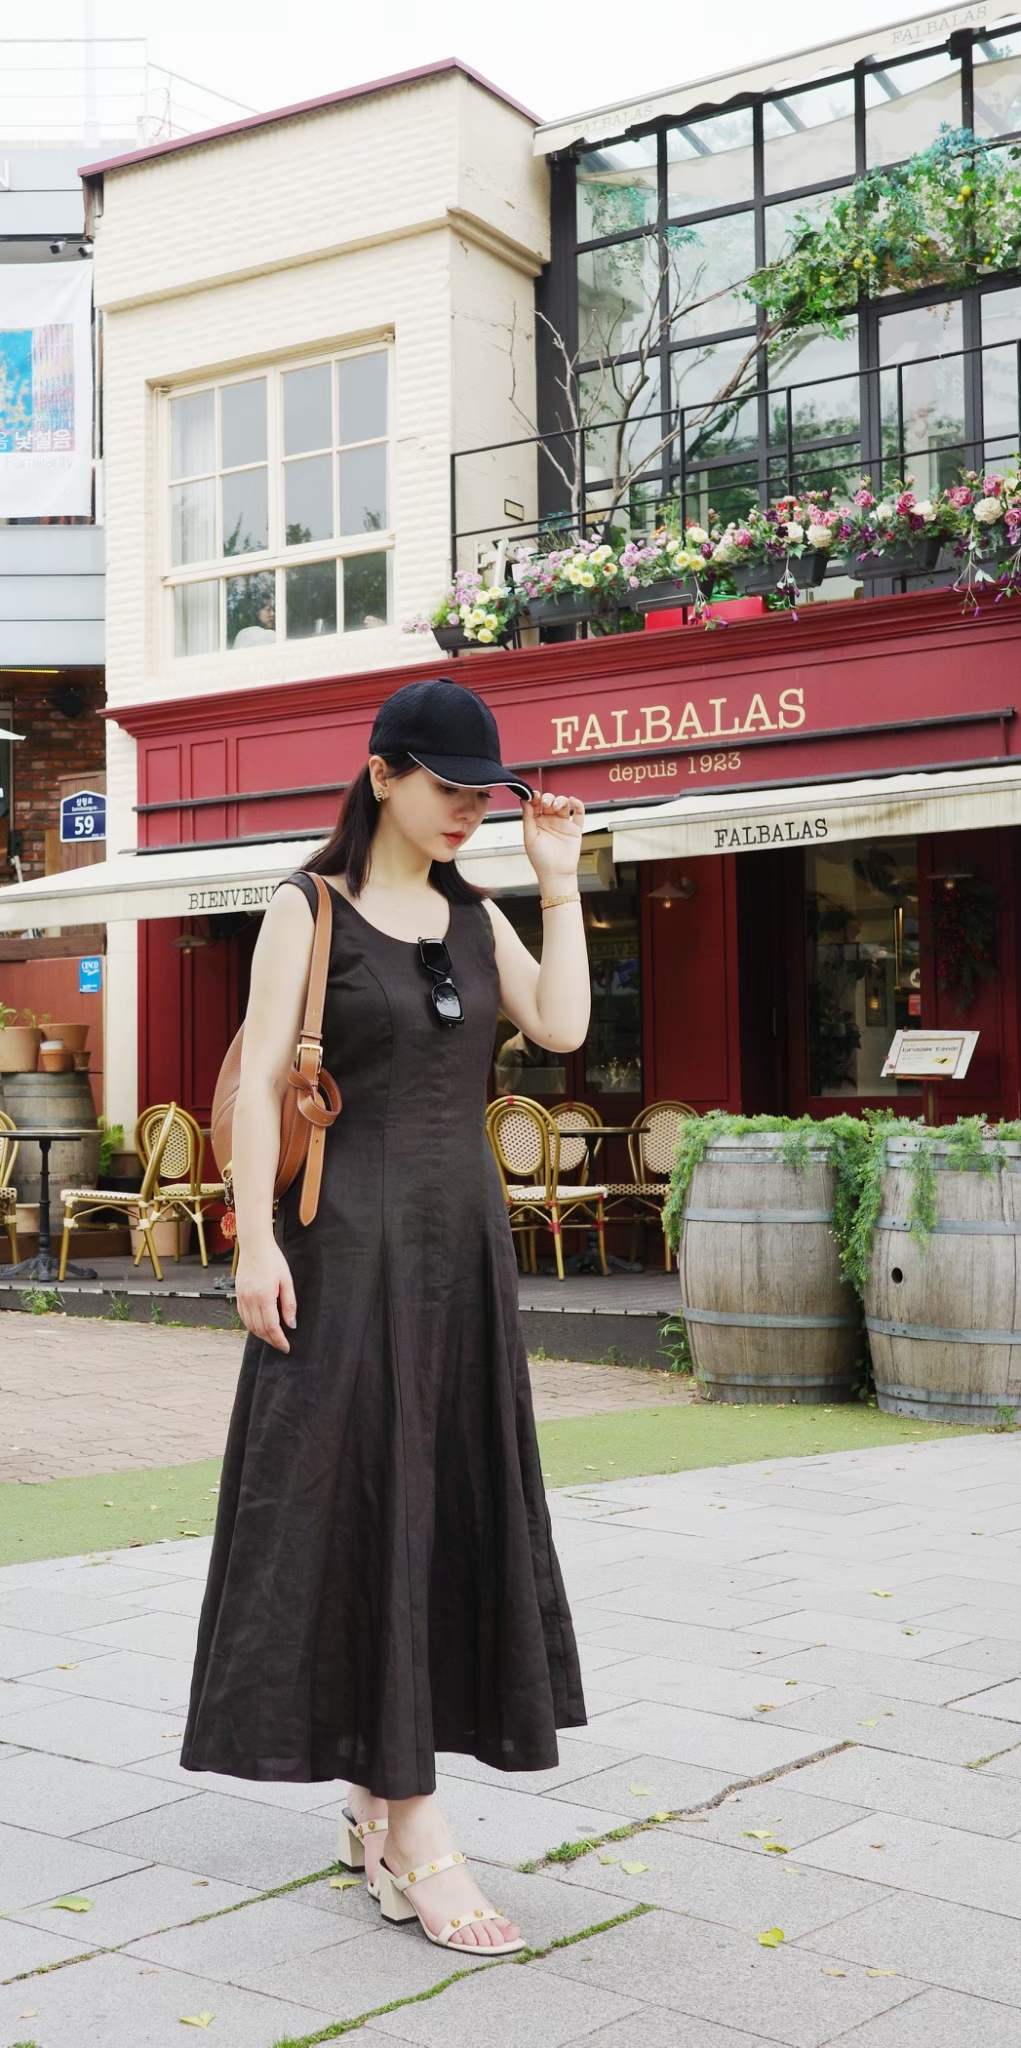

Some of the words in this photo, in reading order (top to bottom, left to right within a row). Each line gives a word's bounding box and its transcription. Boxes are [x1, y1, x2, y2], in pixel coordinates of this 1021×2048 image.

[891, 6, 987, 44] FALBALAS
[572, 105, 653, 136] FALBALAS
[15, 428, 71, 450] 낯설음
[551, 688, 806, 754] FALBALAS
[609, 760, 677, 784] depuis
[687, 752, 742, 775] 1923
[74, 815, 95, 836] 59
[714, 818, 828, 848] FALBALAS
